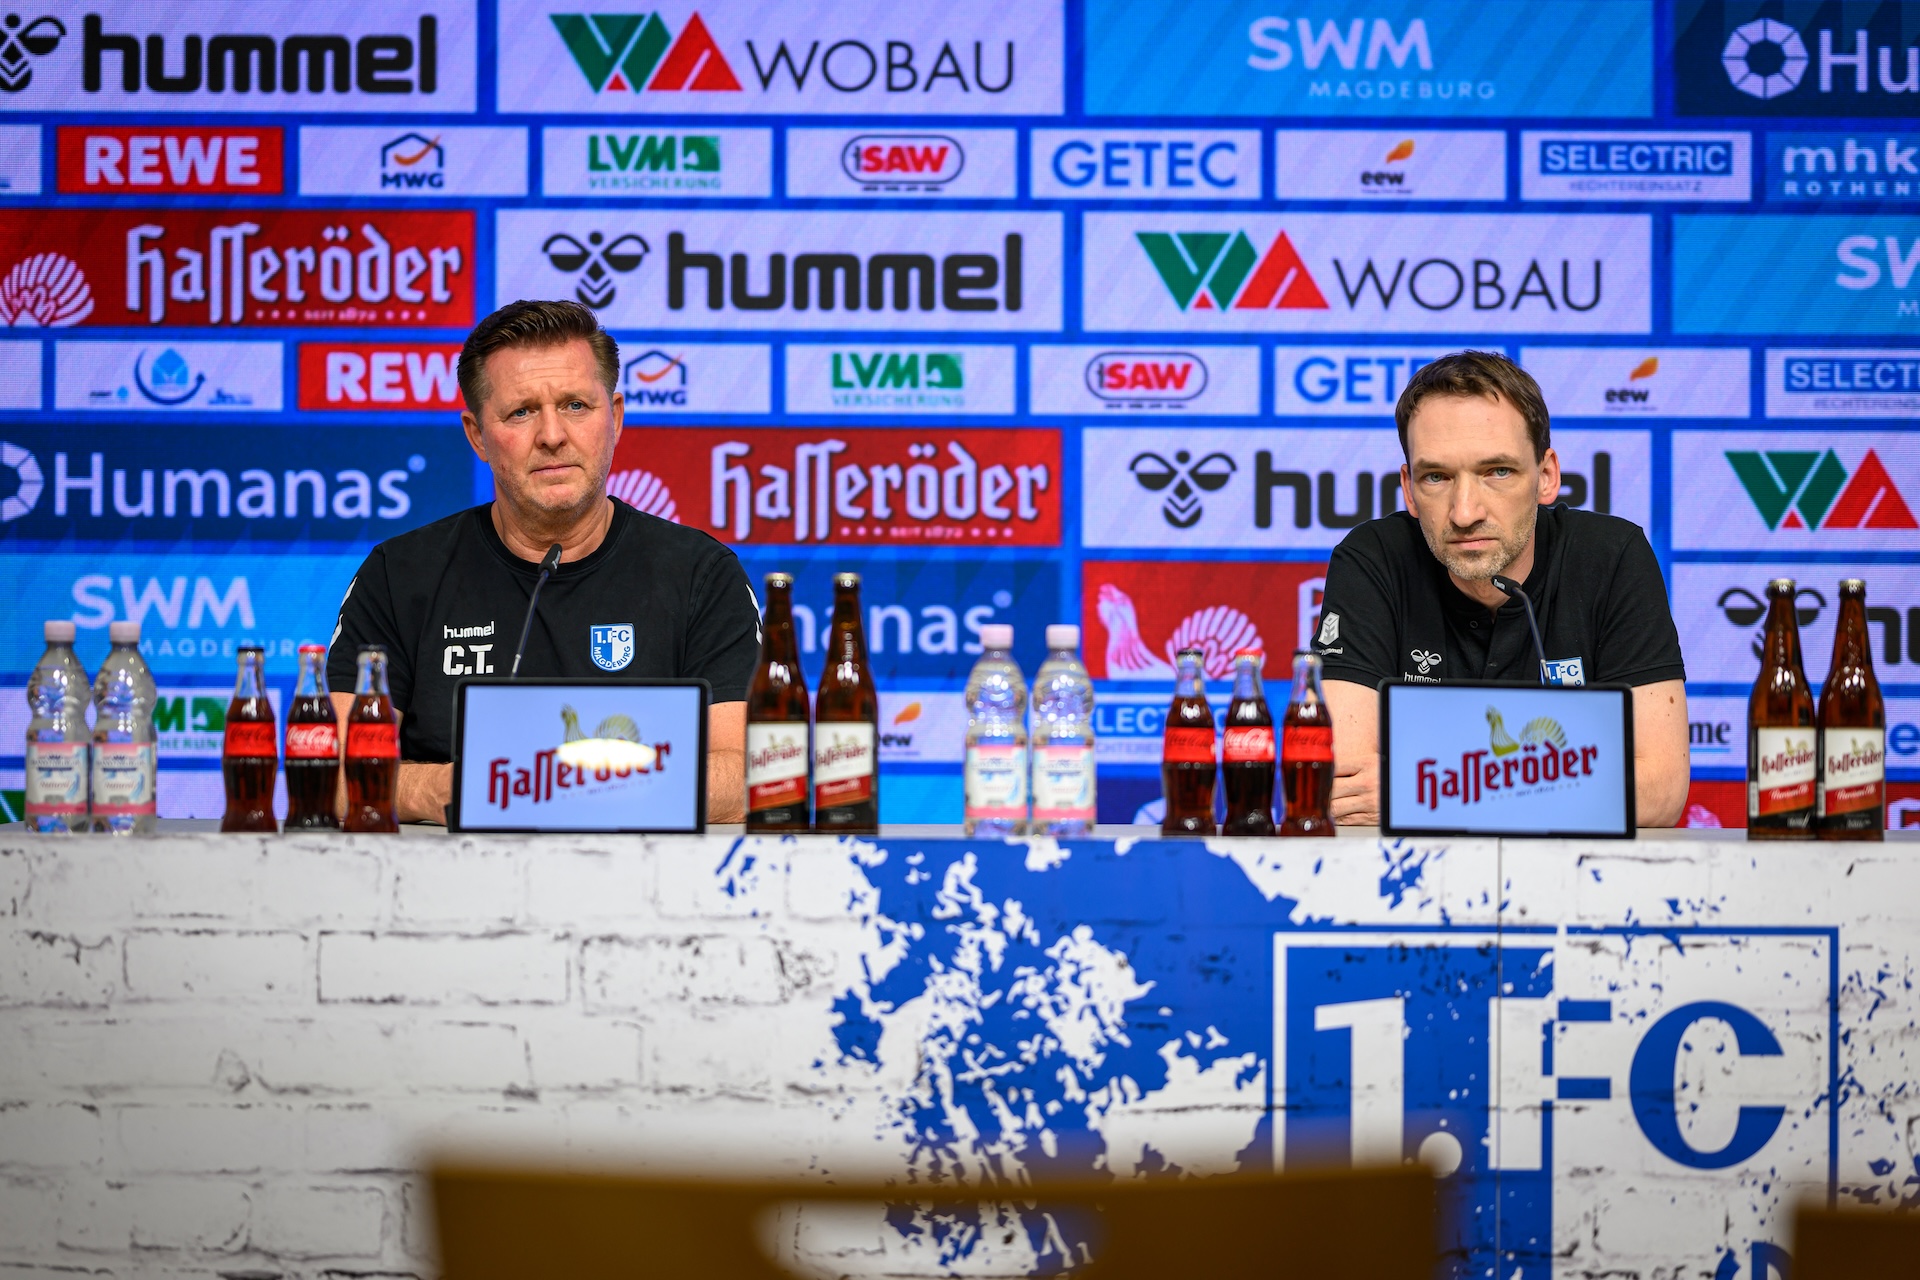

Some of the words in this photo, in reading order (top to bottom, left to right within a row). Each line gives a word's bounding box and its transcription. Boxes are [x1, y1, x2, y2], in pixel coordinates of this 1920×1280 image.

[82, 14, 437, 94] hummel
[1247, 16, 1432, 70] SWM
[746, 41, 1014, 93] WOBAU
[1309, 81, 1495, 99] MAGDEBURG
[84, 136, 260, 185] REWE
[588, 135, 676, 171] LVM
[1052, 141, 1237, 188] GETEC
[1545, 144, 1726, 171] SELECTRIC
[1783, 137, 1919, 174] mhk
[381, 172, 444, 189] MWG
[1361, 171, 1404, 186] eew
[1784, 181, 1920, 196] ROTHEN
[667, 231, 1022, 312] hummel
[1333, 258, 1602, 311] WOBAU
[326, 352, 460, 402] REW
[832, 353, 919, 389] LVM
[1295, 357, 1428, 403] GET
[1790, 362, 1920, 389] SELECT
[625, 390, 688, 406] MWG
[1605, 390, 1649, 403] eew
[54, 452, 411, 519] Humanas
[71, 574, 256, 630] SWM
[444, 621, 495, 639] hummel
[594, 629, 630, 644] 1.FC
[443, 644, 494, 676] C.T.
[593, 646, 631, 668] MAGDEBURG
